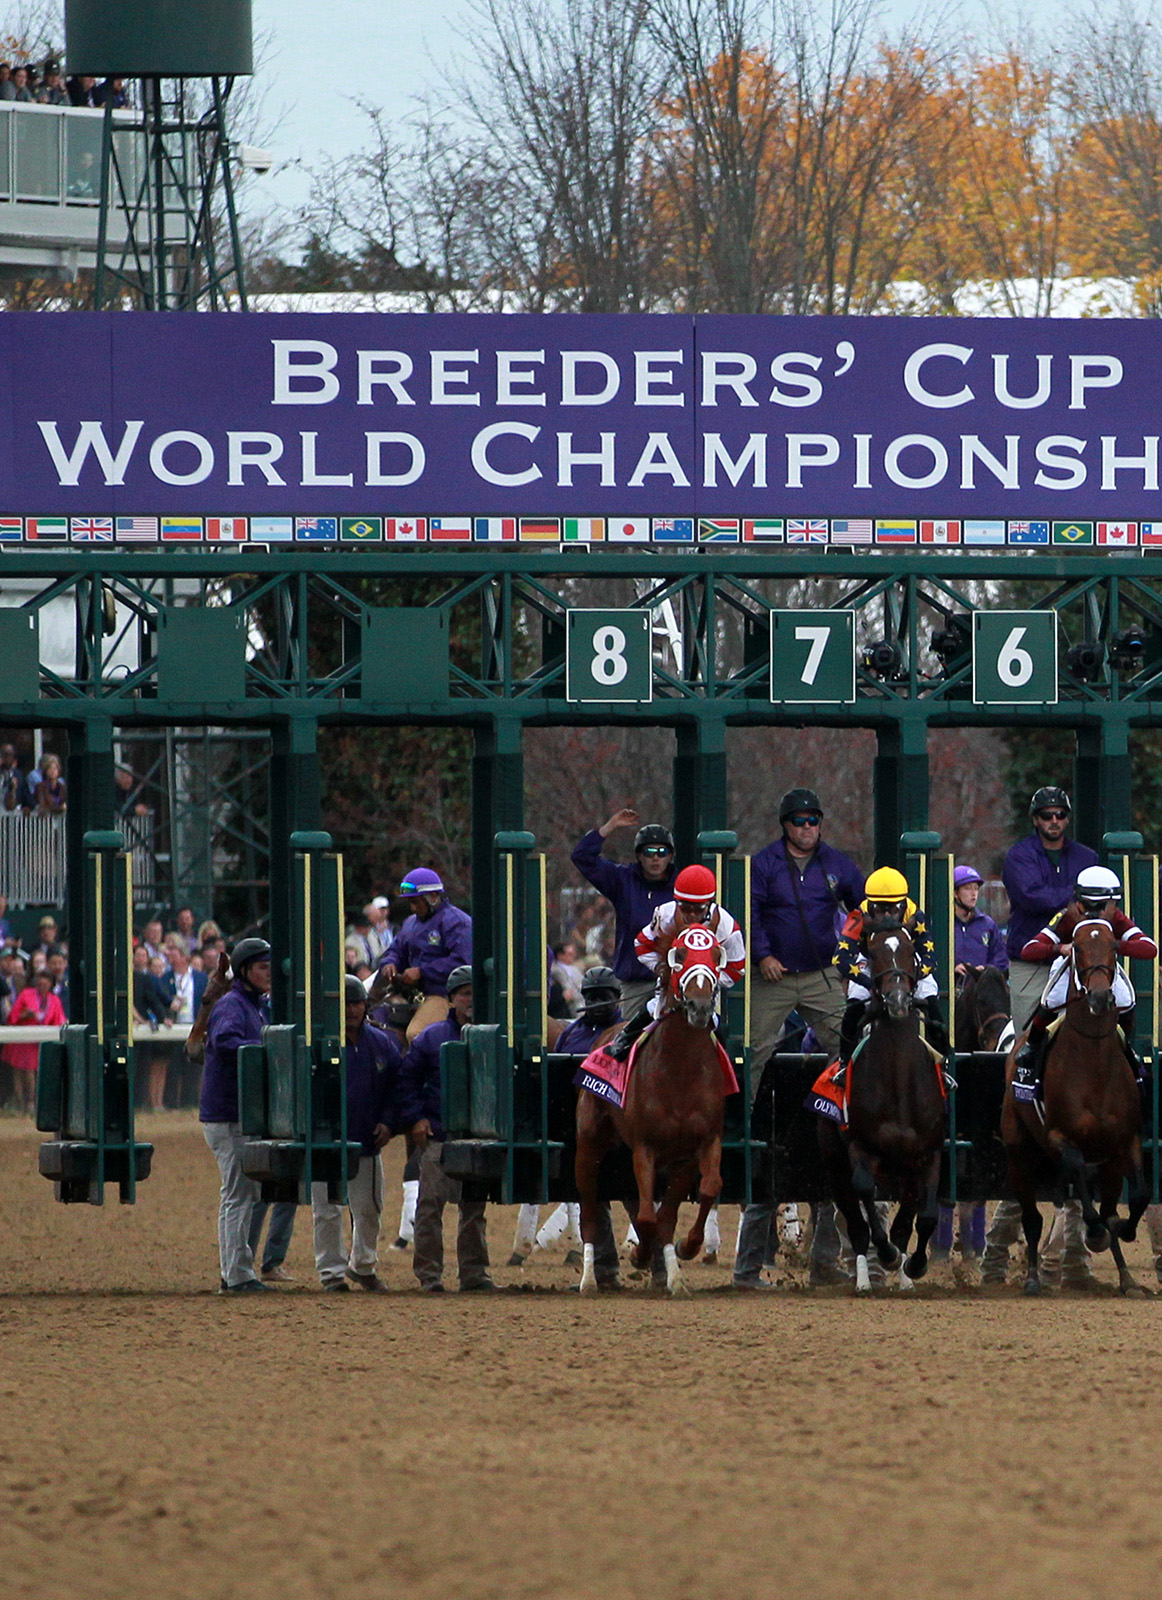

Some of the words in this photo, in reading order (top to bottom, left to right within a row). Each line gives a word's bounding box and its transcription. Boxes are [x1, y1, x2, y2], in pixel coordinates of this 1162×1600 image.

[904, 344, 1123, 409] CUP
[37, 421, 425, 487] WORLD
[592, 626, 627, 684] 8
[796, 627, 830, 685] 7
[998, 628, 1032, 686] 6
[692, 933, 706, 947] R
[848, 916, 861, 931] 7
[582, 1075, 608, 1096] RICH
